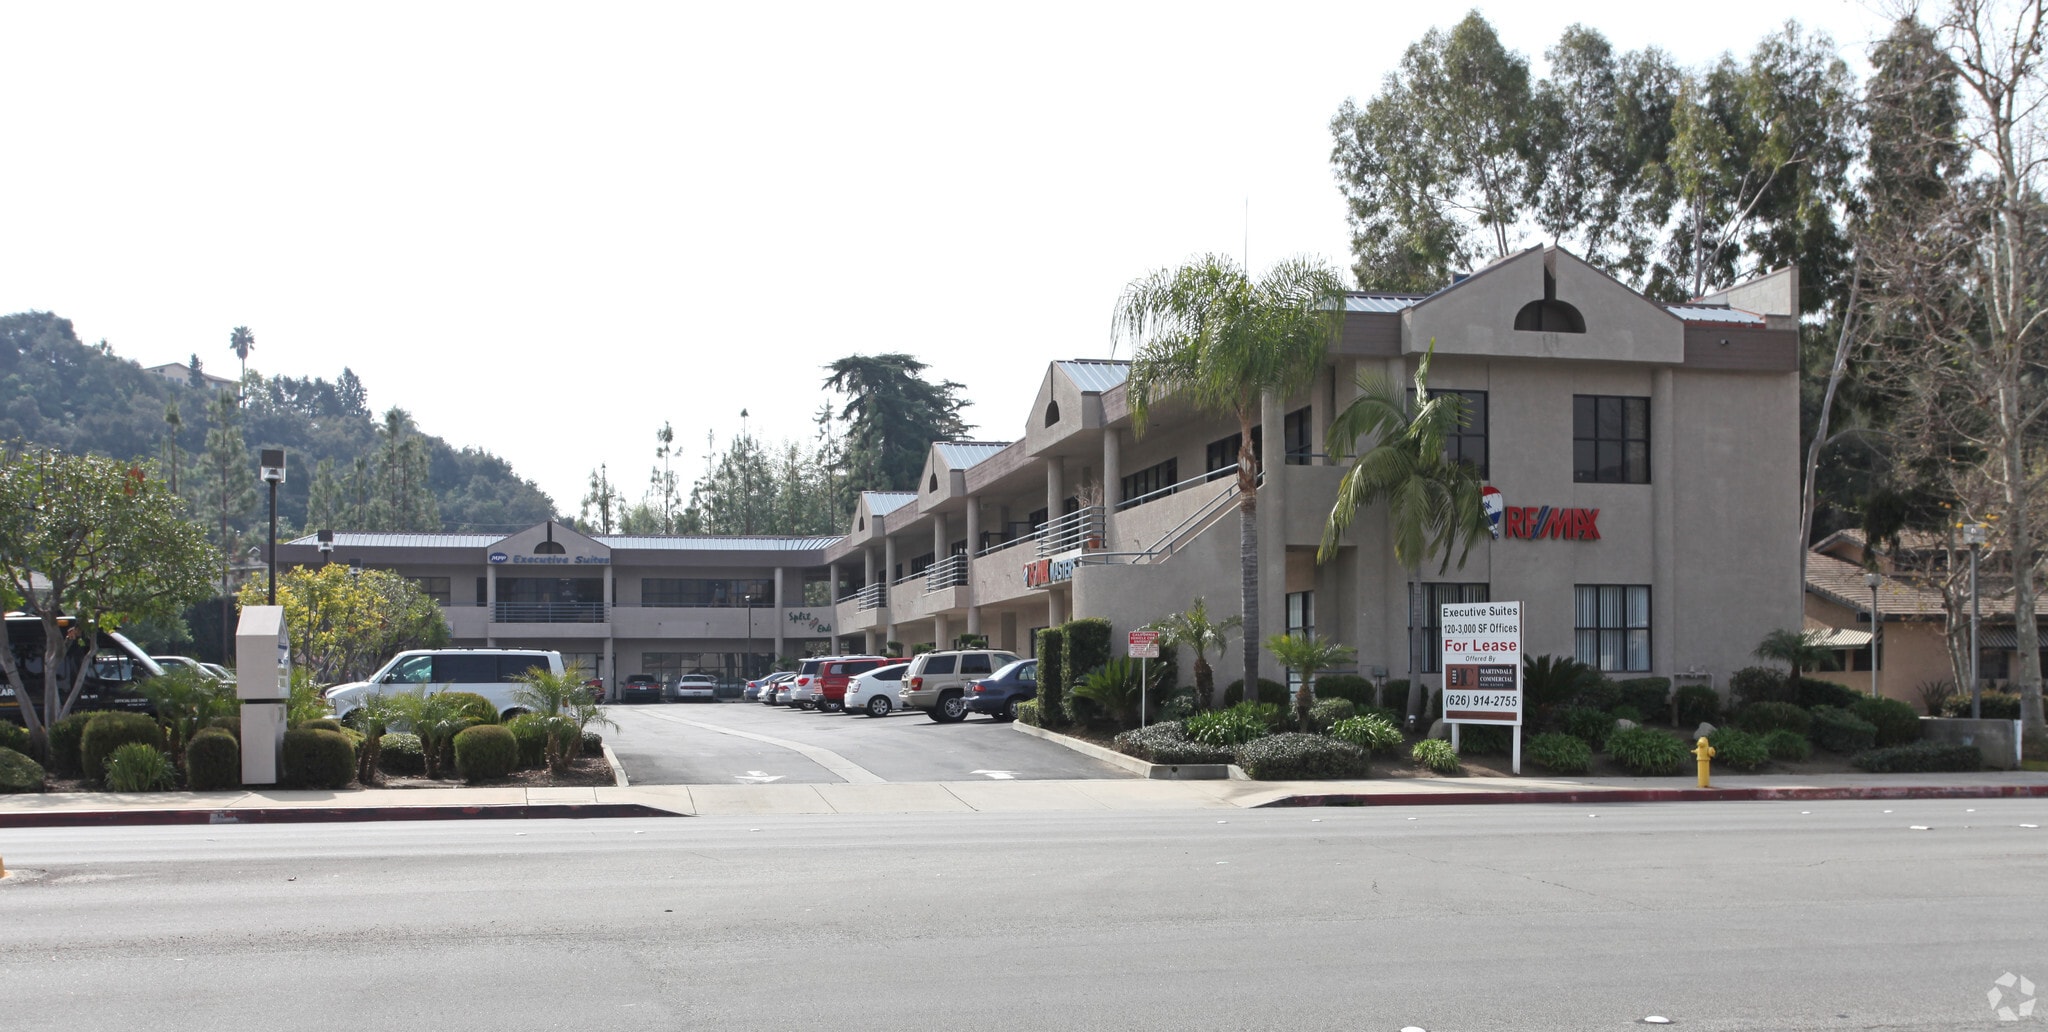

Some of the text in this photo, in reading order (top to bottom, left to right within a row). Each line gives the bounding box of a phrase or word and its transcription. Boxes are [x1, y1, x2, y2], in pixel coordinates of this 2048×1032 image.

[1505, 505, 1601, 540] RE/MAX
[513, 555, 610, 564] Executive Suites
[1443, 605, 1518, 617] Executive Suites
[789, 611, 811, 624] Split
[1444, 623, 1518, 635] 120-3,000 SF Offices
[1445, 639, 1517, 652] For Lease
[1488, 655, 1496, 663] By
[1445, 694, 1517, 708] (626) 914-2755
